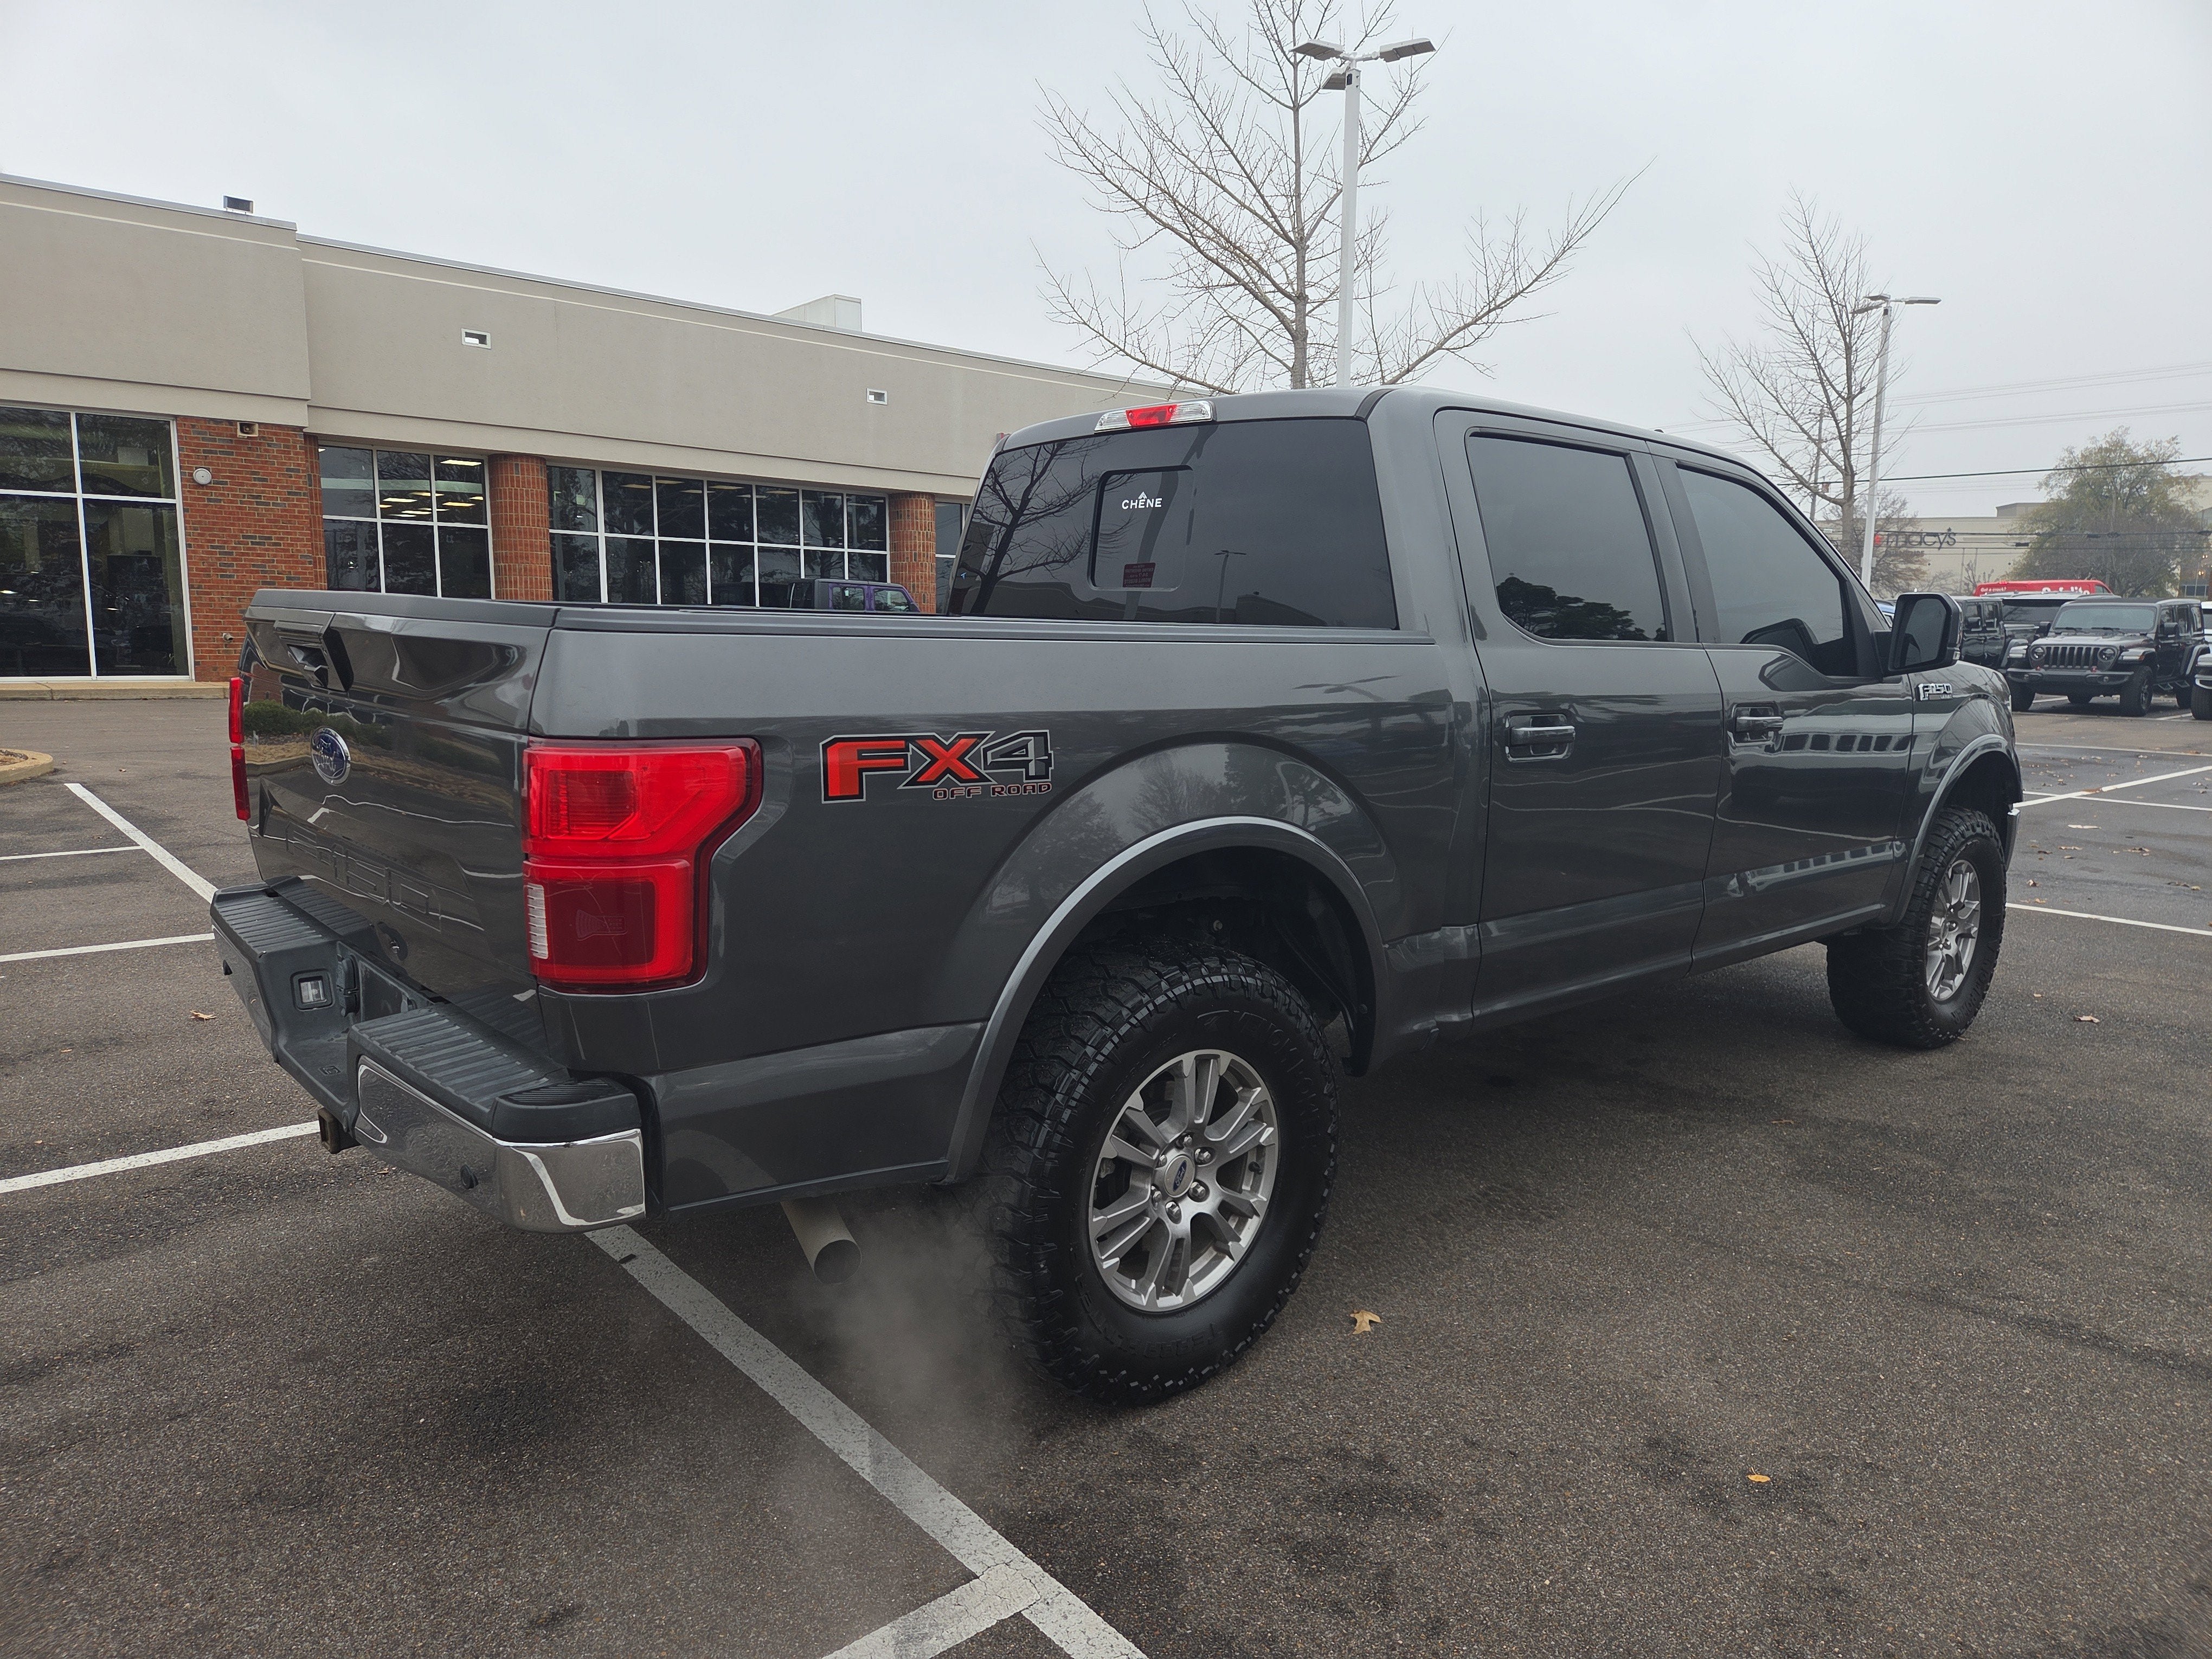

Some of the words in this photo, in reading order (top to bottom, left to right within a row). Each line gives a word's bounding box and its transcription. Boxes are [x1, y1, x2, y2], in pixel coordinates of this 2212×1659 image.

[820, 730, 1053, 803] FX4
[932, 786, 982, 801] OFF
[991, 782, 1052, 798] ROAD
